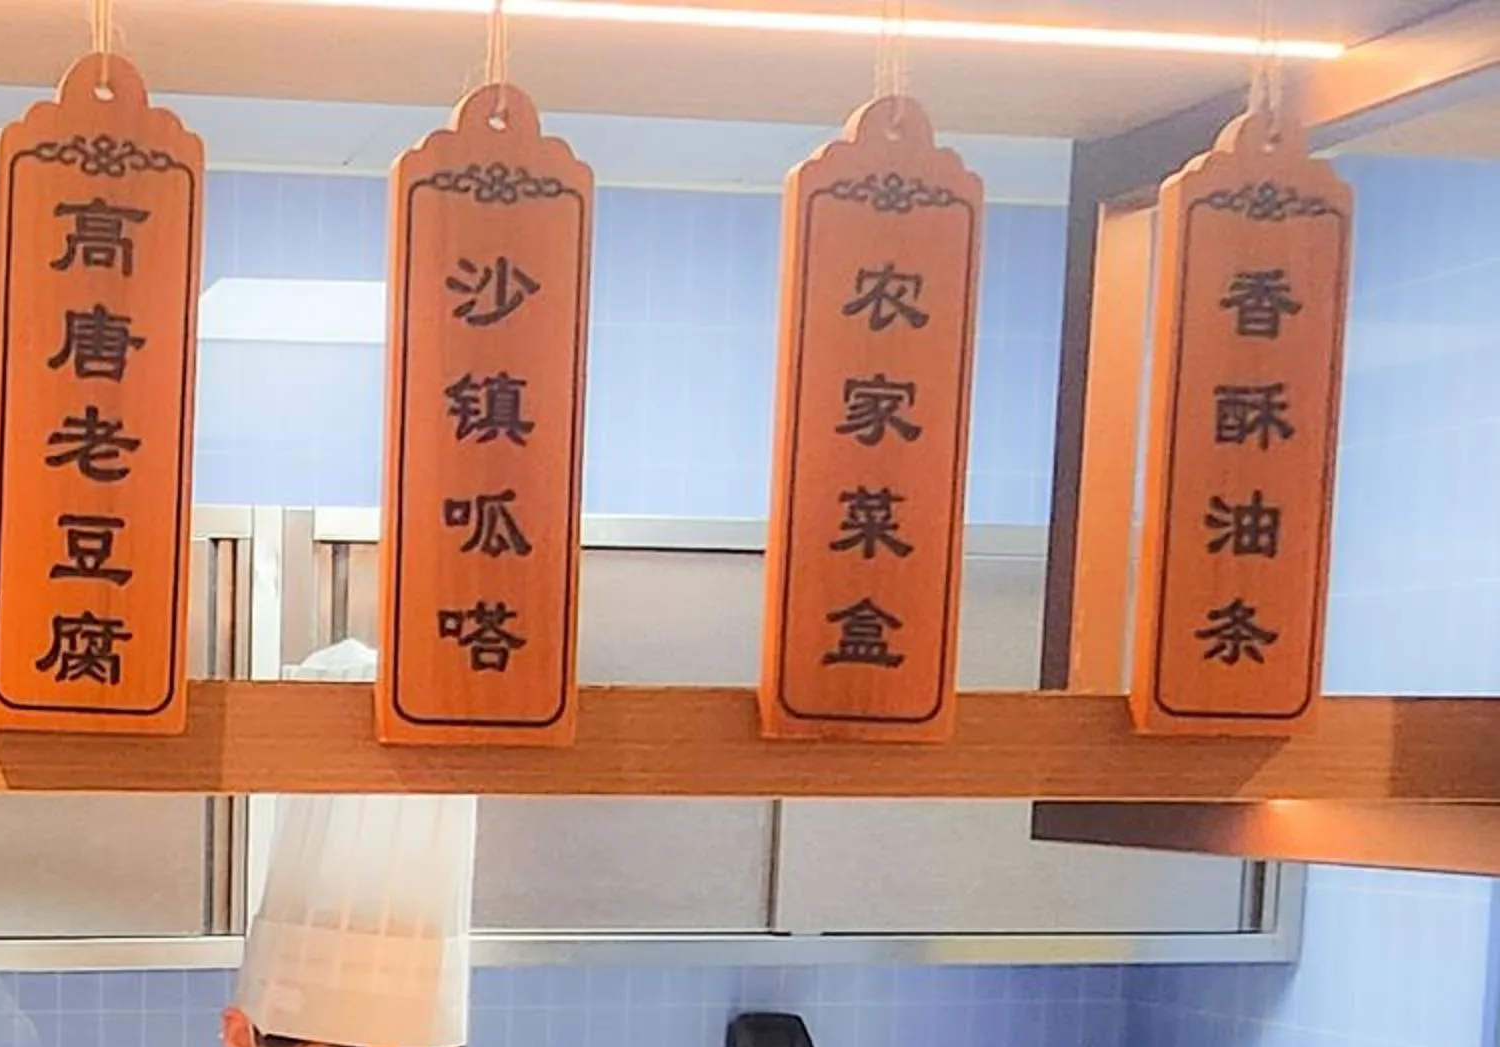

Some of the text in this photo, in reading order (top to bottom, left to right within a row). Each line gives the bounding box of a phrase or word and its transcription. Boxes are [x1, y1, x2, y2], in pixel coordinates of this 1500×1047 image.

[35, 197, 151, 686] 高唐老豆腐
[436, 256, 542, 673] 沙镇呱嗒
[821, 263, 931, 669] 农家菜盒
[1194, 269, 1303, 667] 香酥油条
